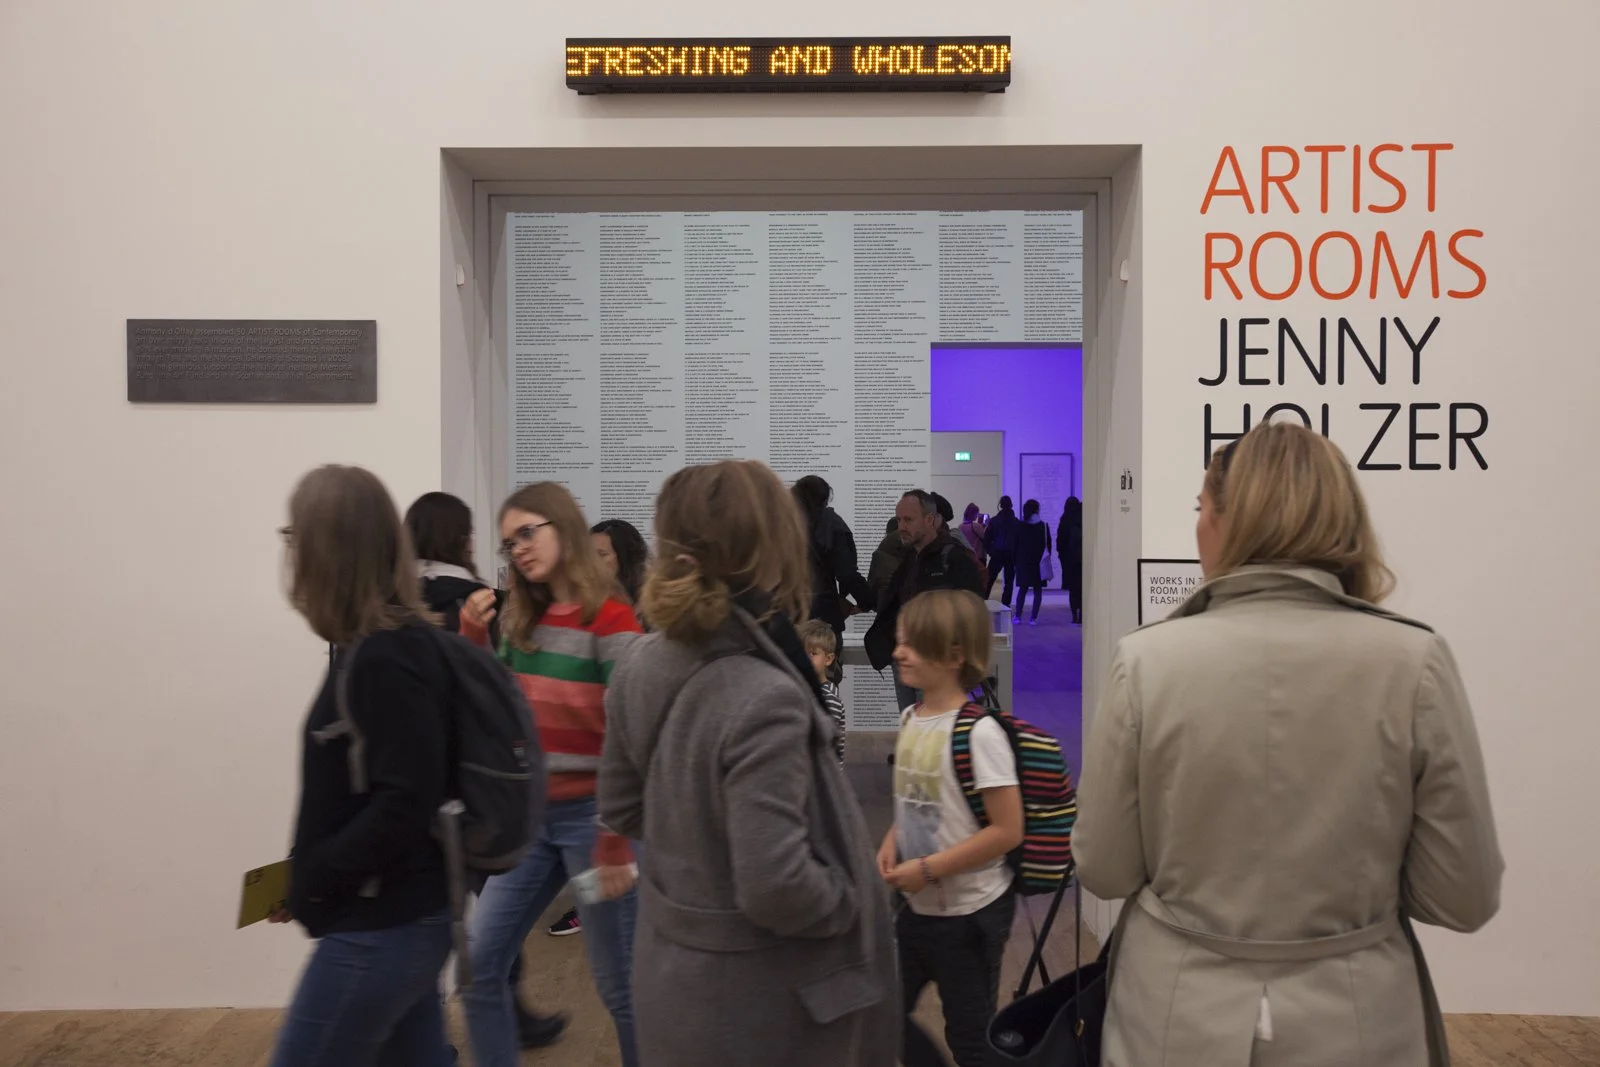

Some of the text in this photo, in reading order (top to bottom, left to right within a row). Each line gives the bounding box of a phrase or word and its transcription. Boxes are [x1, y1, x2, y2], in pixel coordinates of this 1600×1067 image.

[769, 45, 831, 74] AND
[1200, 143, 1454, 215] ARTIST
[1204, 229, 1487, 301] ROOMS
[248, 328, 273, 337] ARTIST
[274, 328, 301, 337] ROOMS
[312, 328, 362, 337] Contemporary
[1198, 317, 1441, 387] JENNY
[1150, 576, 1183, 585] WORKS
[1185, 576, 1195, 585] IN
[1150, 586, 1179, 595] ROOM
